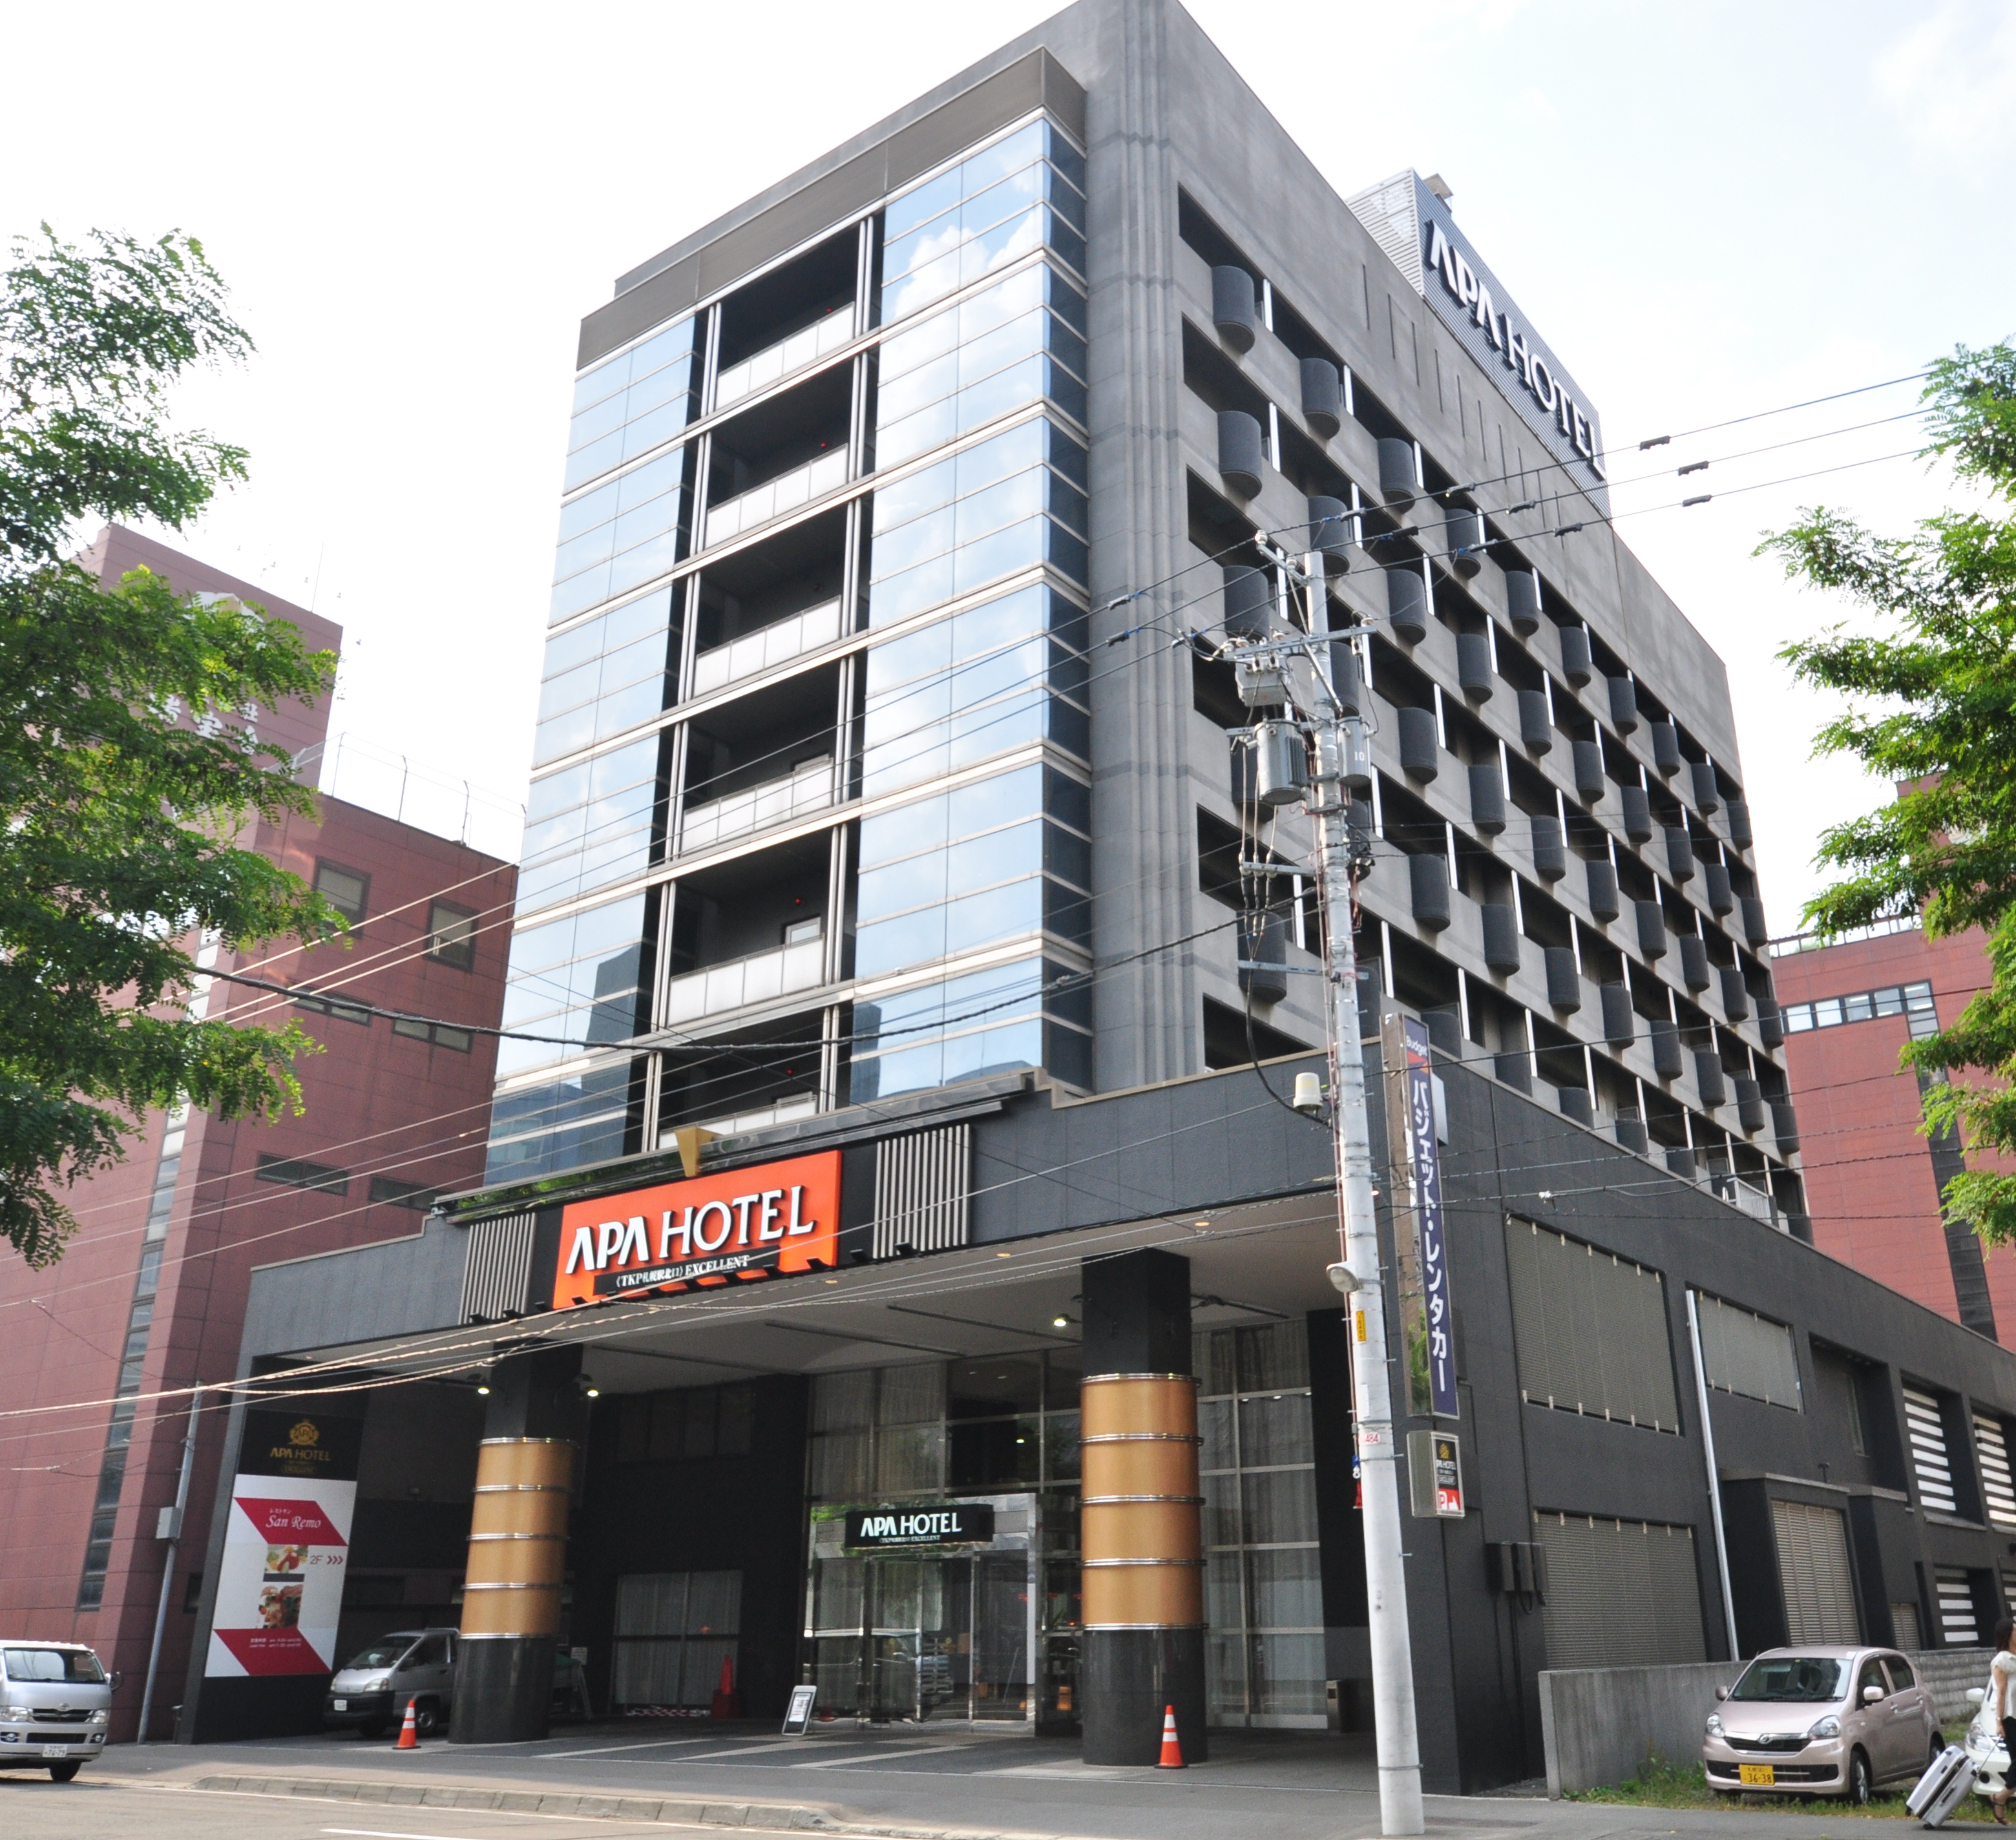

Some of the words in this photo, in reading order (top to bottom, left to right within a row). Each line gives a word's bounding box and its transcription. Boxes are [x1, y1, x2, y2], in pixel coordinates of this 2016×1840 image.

[1429, 220, 1502, 351] APA
[1503, 313, 1607, 481] HOTEL
[1354, 751, 1365, 761] 10
[1406, 1035, 1427, 1057] Budget
[565, 1215, 649, 1275] APA
[658, 1185, 815, 1259] HOTEL
[685, 1255, 750, 1276] EXCELLENT
[269, 1447, 293, 1458] APA
[295, 1449, 331, 1461] HOTEL
[266, 1515, 288, 1528] San
[291, 1516, 321, 1530] Remo
[860, 1516, 898, 1537] APA
[899, 1512, 962, 1535] HOTEL
[310, 1555, 322, 1565] 2F
[1747, 1773, 1772, 1783] 36-38
